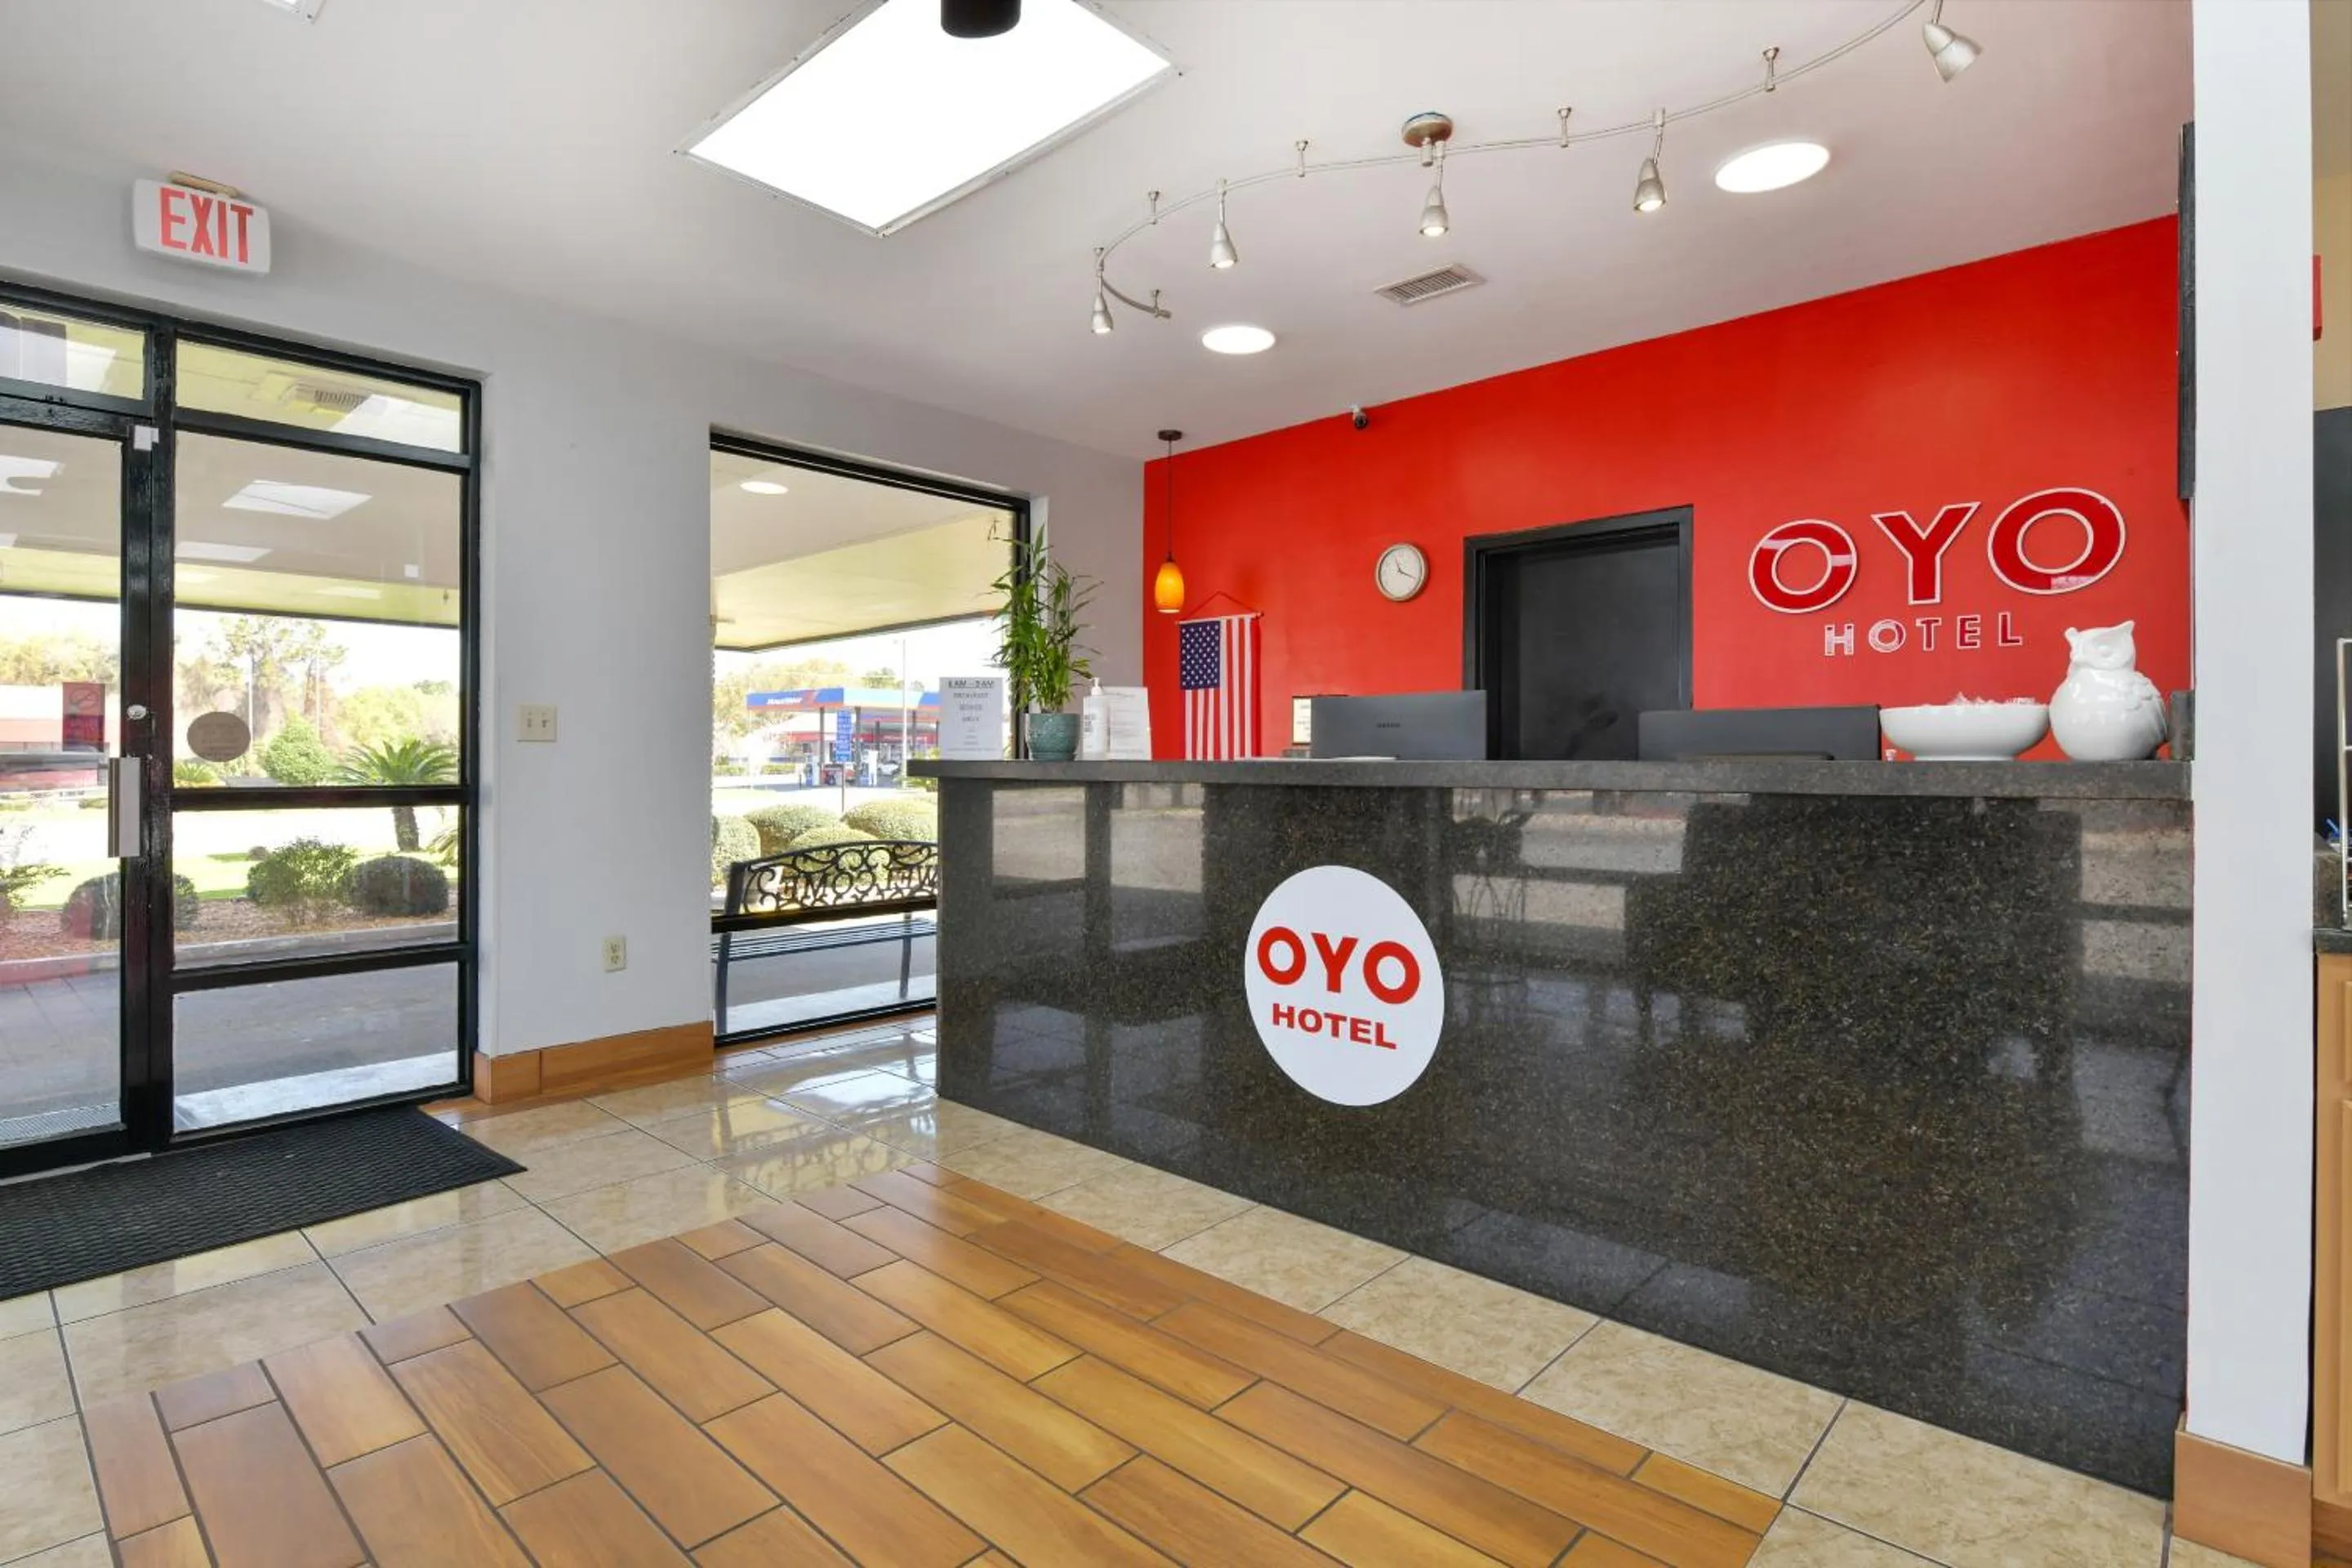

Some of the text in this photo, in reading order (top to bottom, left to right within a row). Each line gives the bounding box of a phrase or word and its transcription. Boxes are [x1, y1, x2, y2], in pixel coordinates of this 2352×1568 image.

[160, 187, 254, 264] EXIT
[1748, 488, 2126, 613] OYO
[1824, 612, 2023, 657] HOTEL
[1258, 926, 1421, 1004] OYO
[1272, 1003, 1397, 1050] HOTEL
